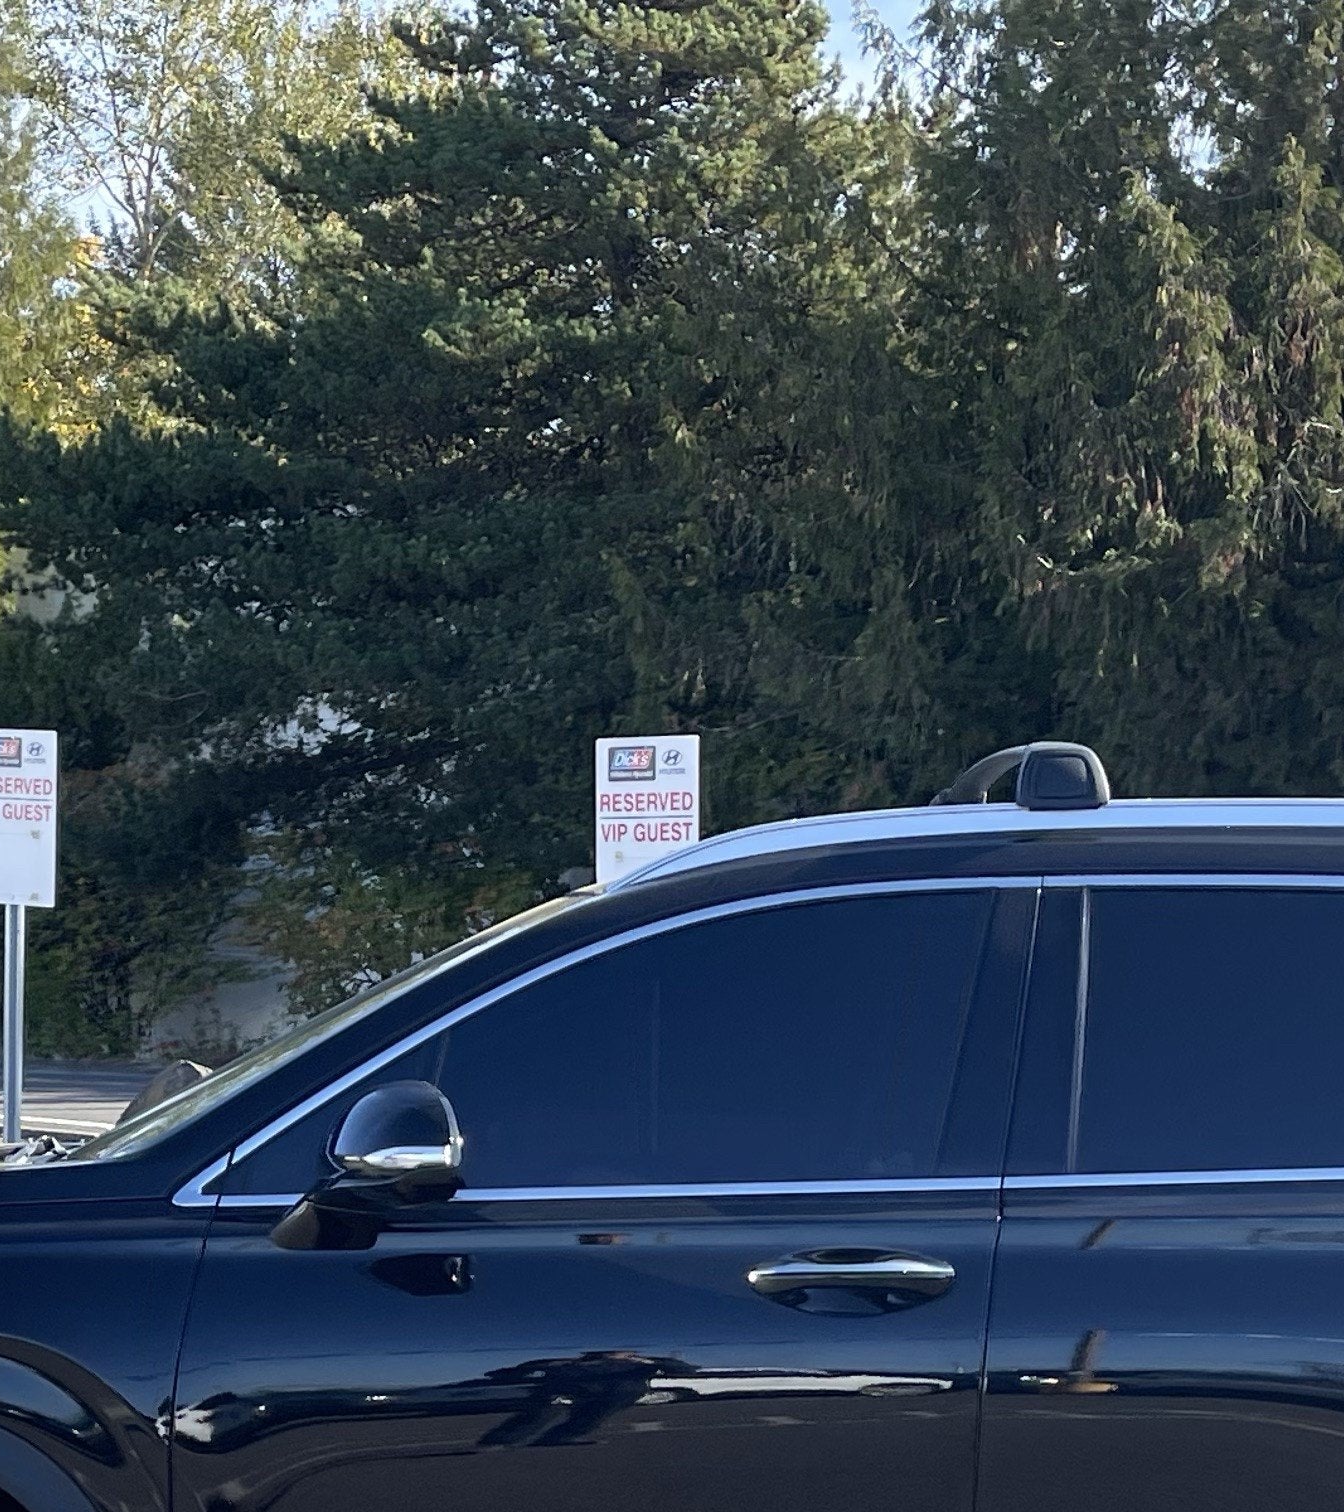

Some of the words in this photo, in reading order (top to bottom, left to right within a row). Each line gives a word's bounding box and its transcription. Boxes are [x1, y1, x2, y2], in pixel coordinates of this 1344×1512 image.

[599, 791, 693, 812] RESERVED
[2, 803, 52, 822] GUEST
[600, 823, 628, 842] VIP
[633, 822, 693, 843] GUEST
